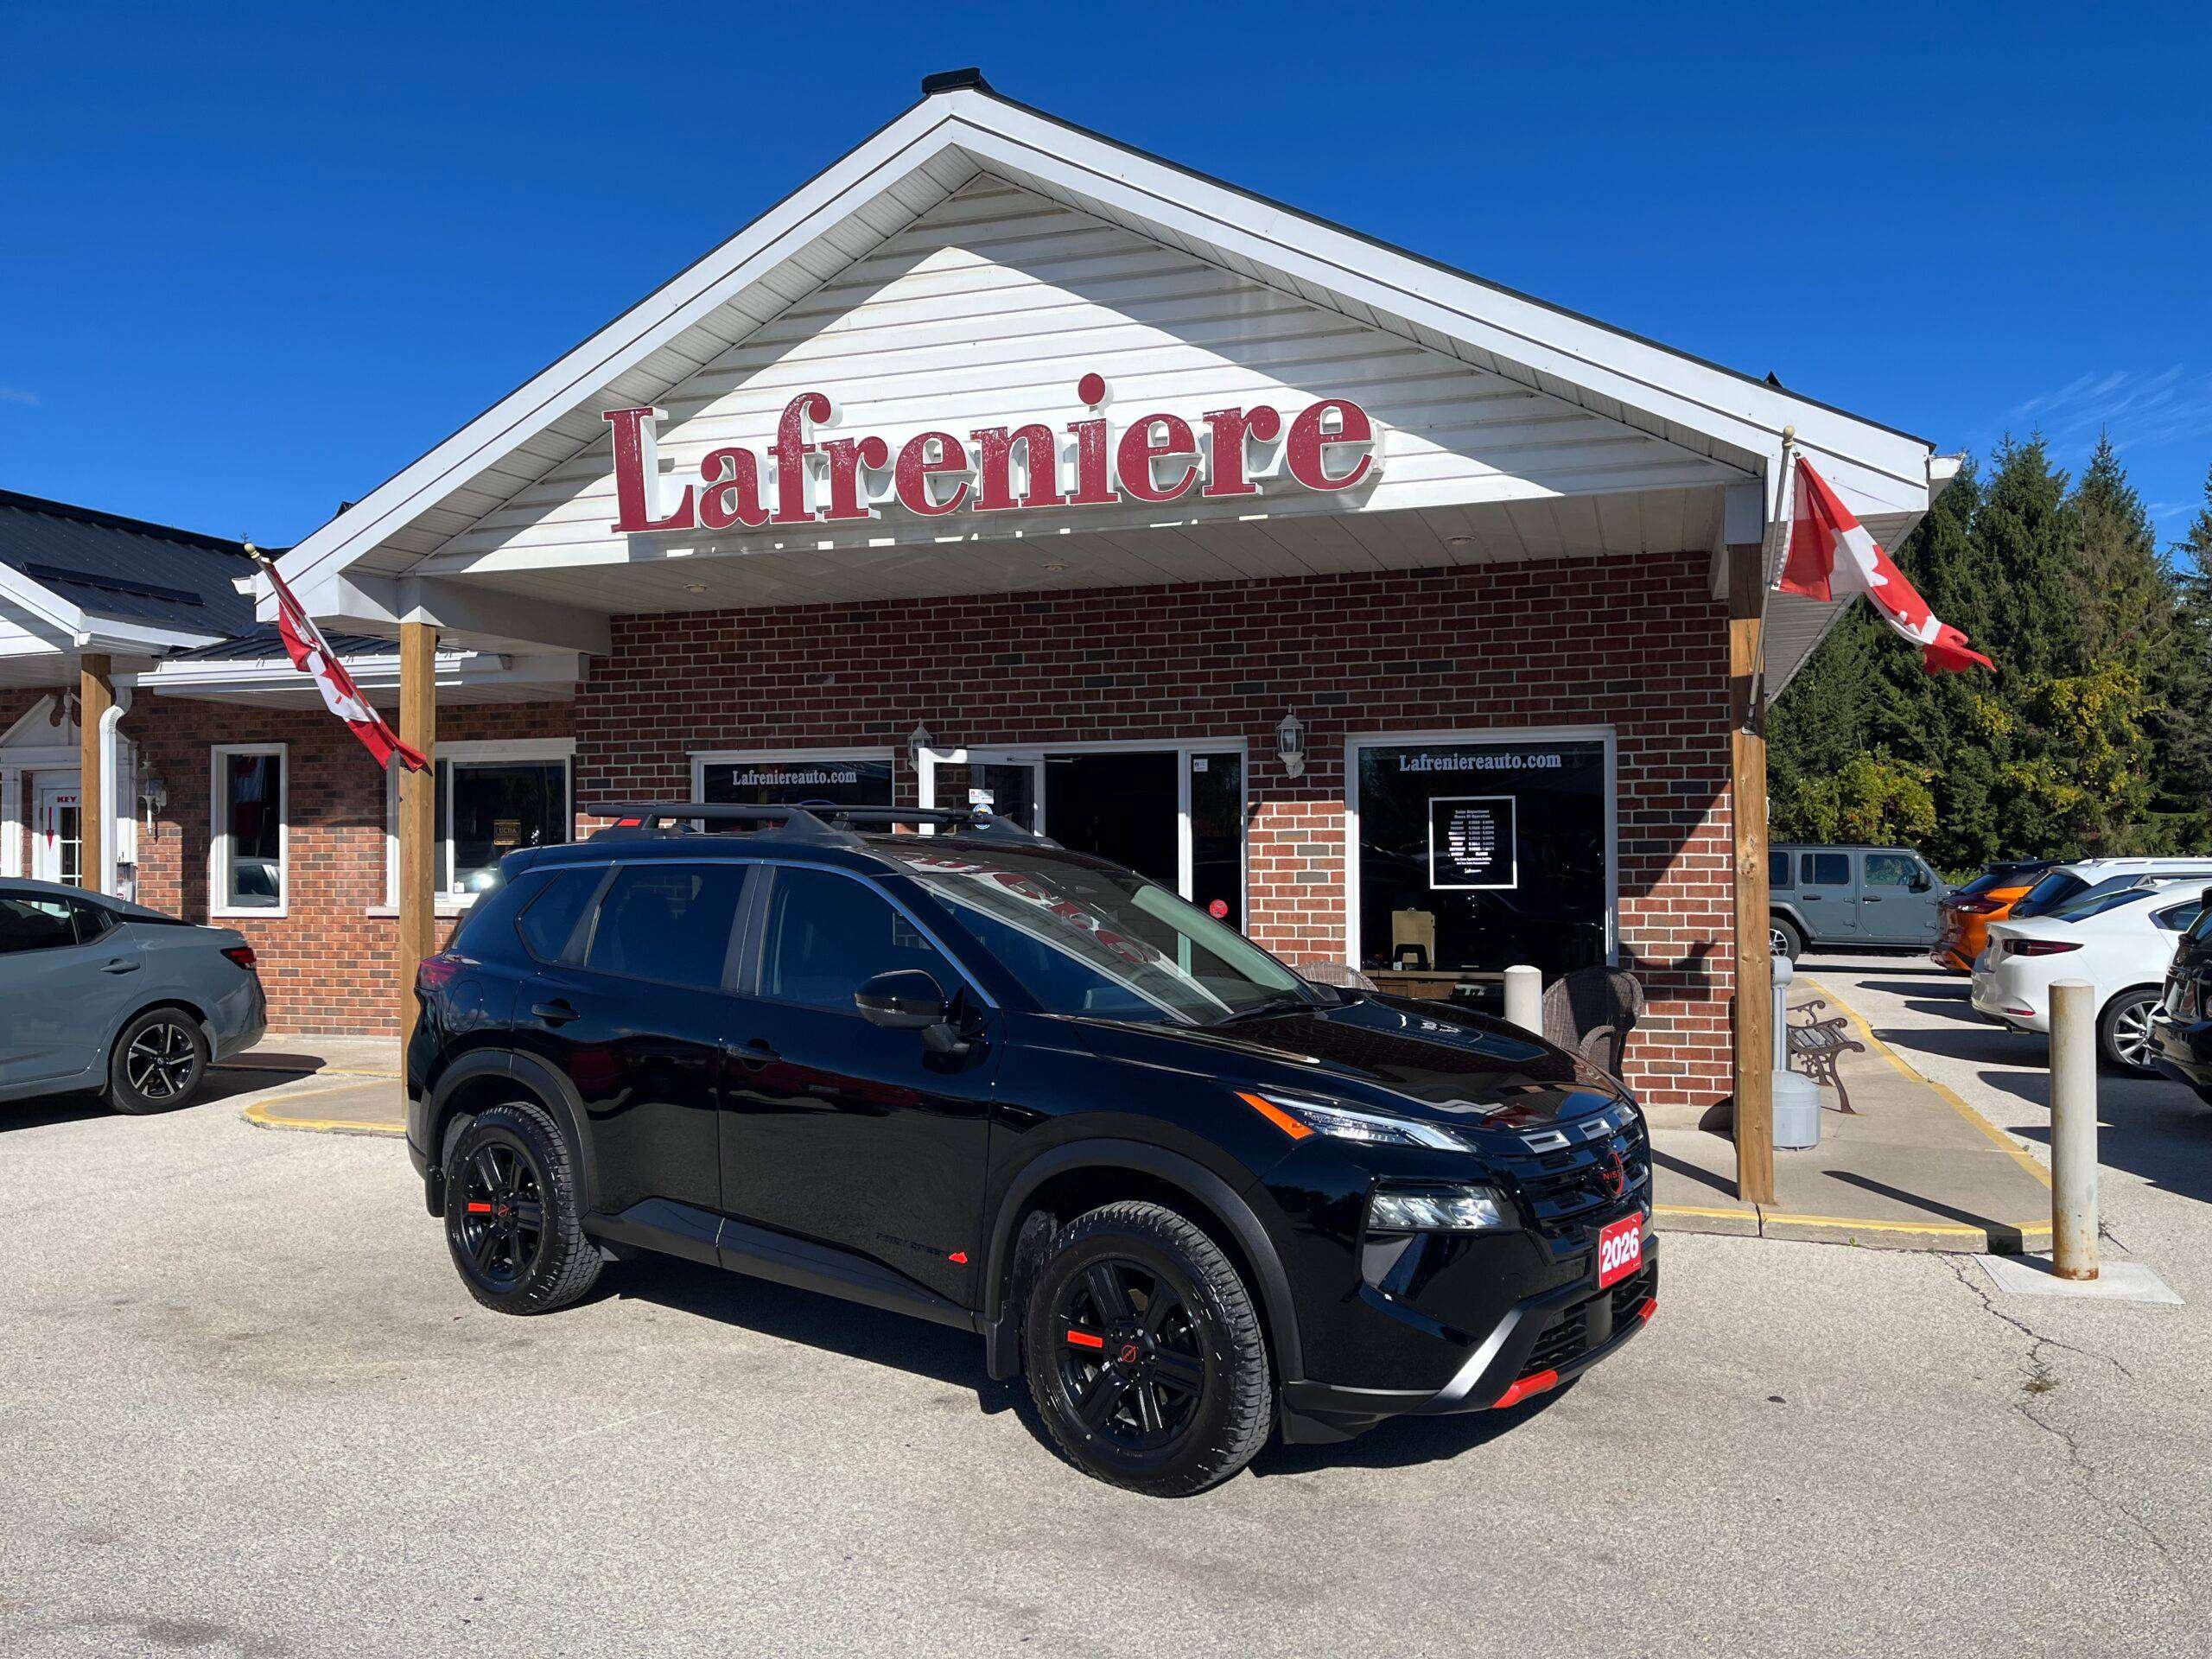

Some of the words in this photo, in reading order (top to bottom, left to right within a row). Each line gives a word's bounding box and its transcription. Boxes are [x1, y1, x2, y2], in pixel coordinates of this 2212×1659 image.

[602, 372, 1376, 533] Lafreniere
[732, 769, 857, 785] Lafreniereauto.com
[1399, 753, 1562, 772] Lafreniereauto.com
[1601, 1227, 1640, 1274] 2026
